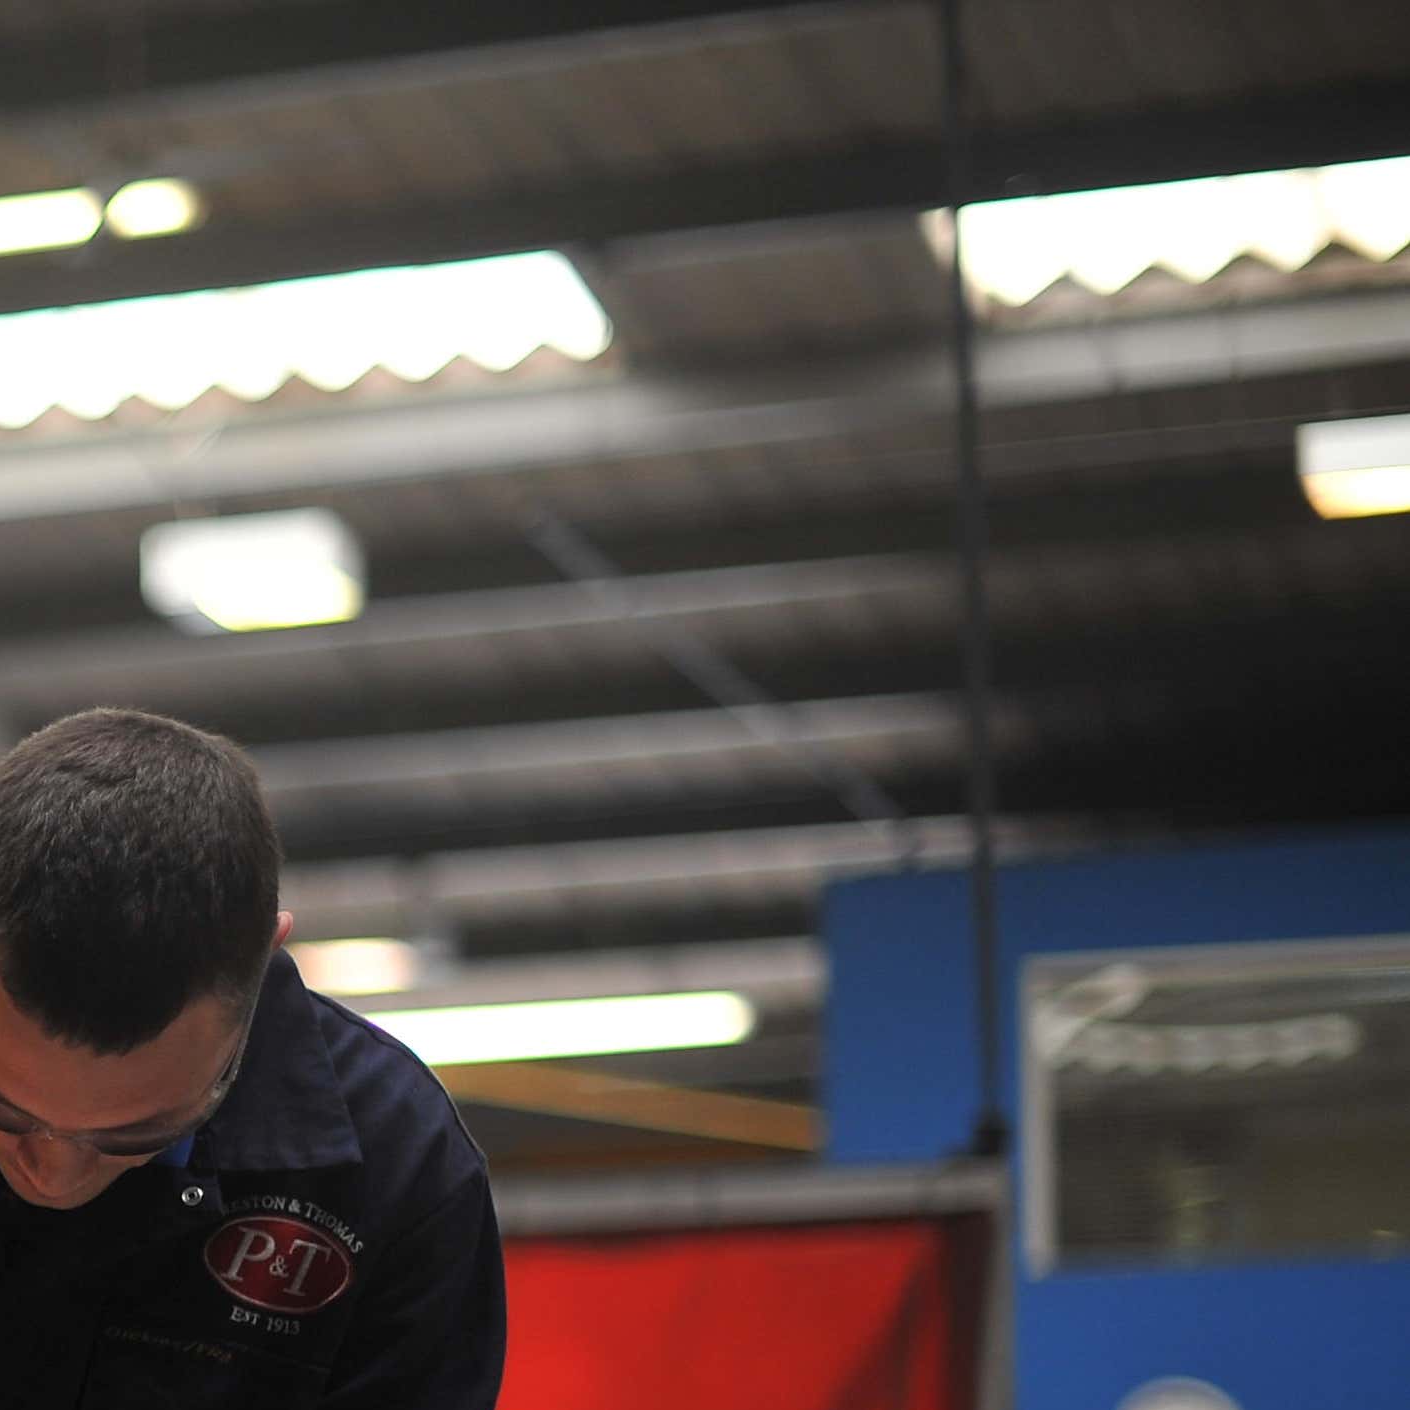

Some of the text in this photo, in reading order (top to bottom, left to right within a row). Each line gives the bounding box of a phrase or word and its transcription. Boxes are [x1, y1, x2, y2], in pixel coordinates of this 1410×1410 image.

[223, 1195, 364, 1253] RESTON & THOMAS
[222, 1226, 331, 1297] P&T
